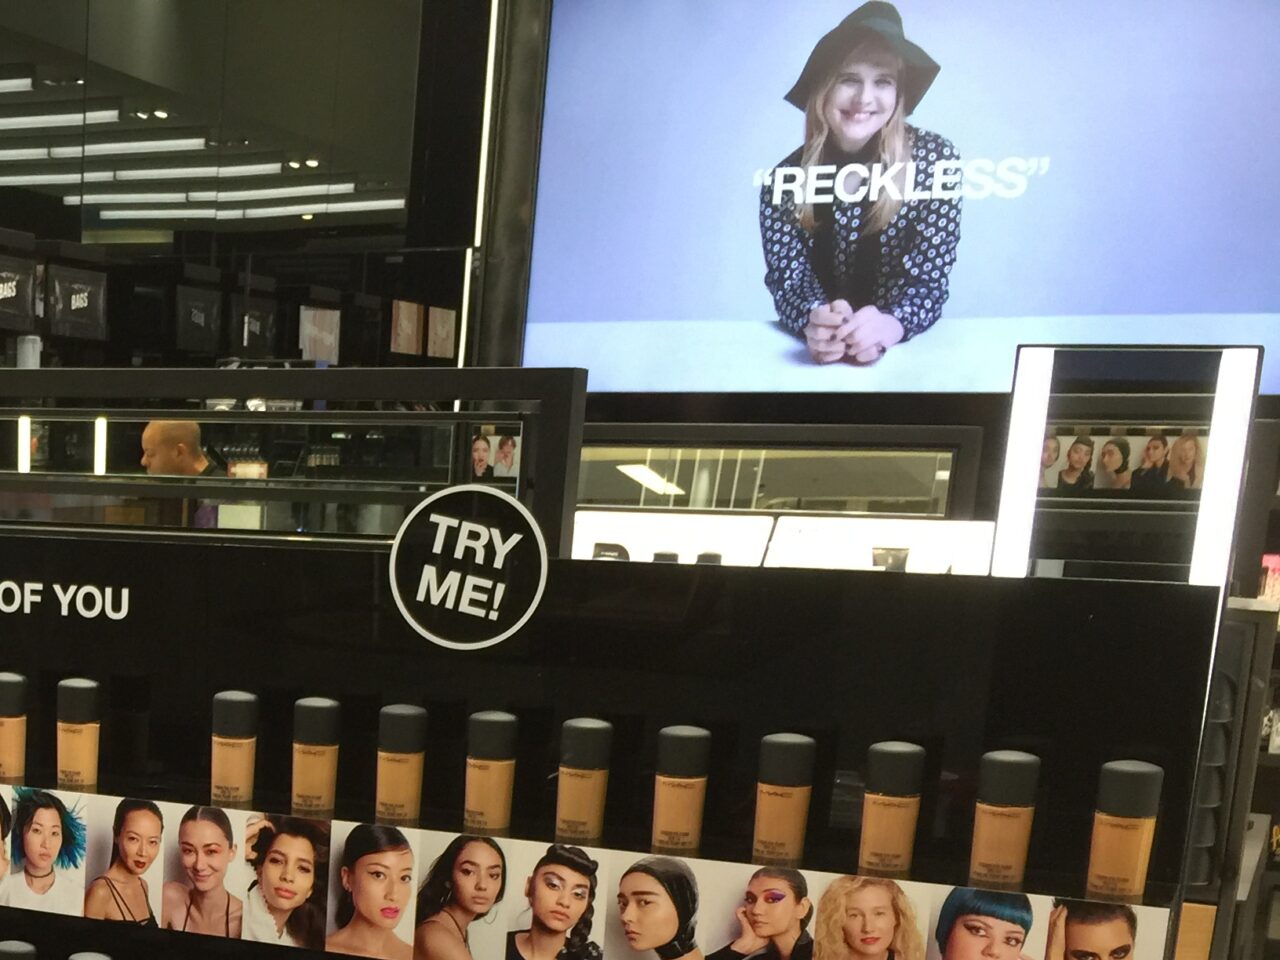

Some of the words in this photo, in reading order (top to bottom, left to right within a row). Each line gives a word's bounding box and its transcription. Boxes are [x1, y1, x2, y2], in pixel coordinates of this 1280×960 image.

[429, 513, 524, 570] TRY
[52, 584, 130, 621] YOU
[416, 564, 506, 621] ME!
